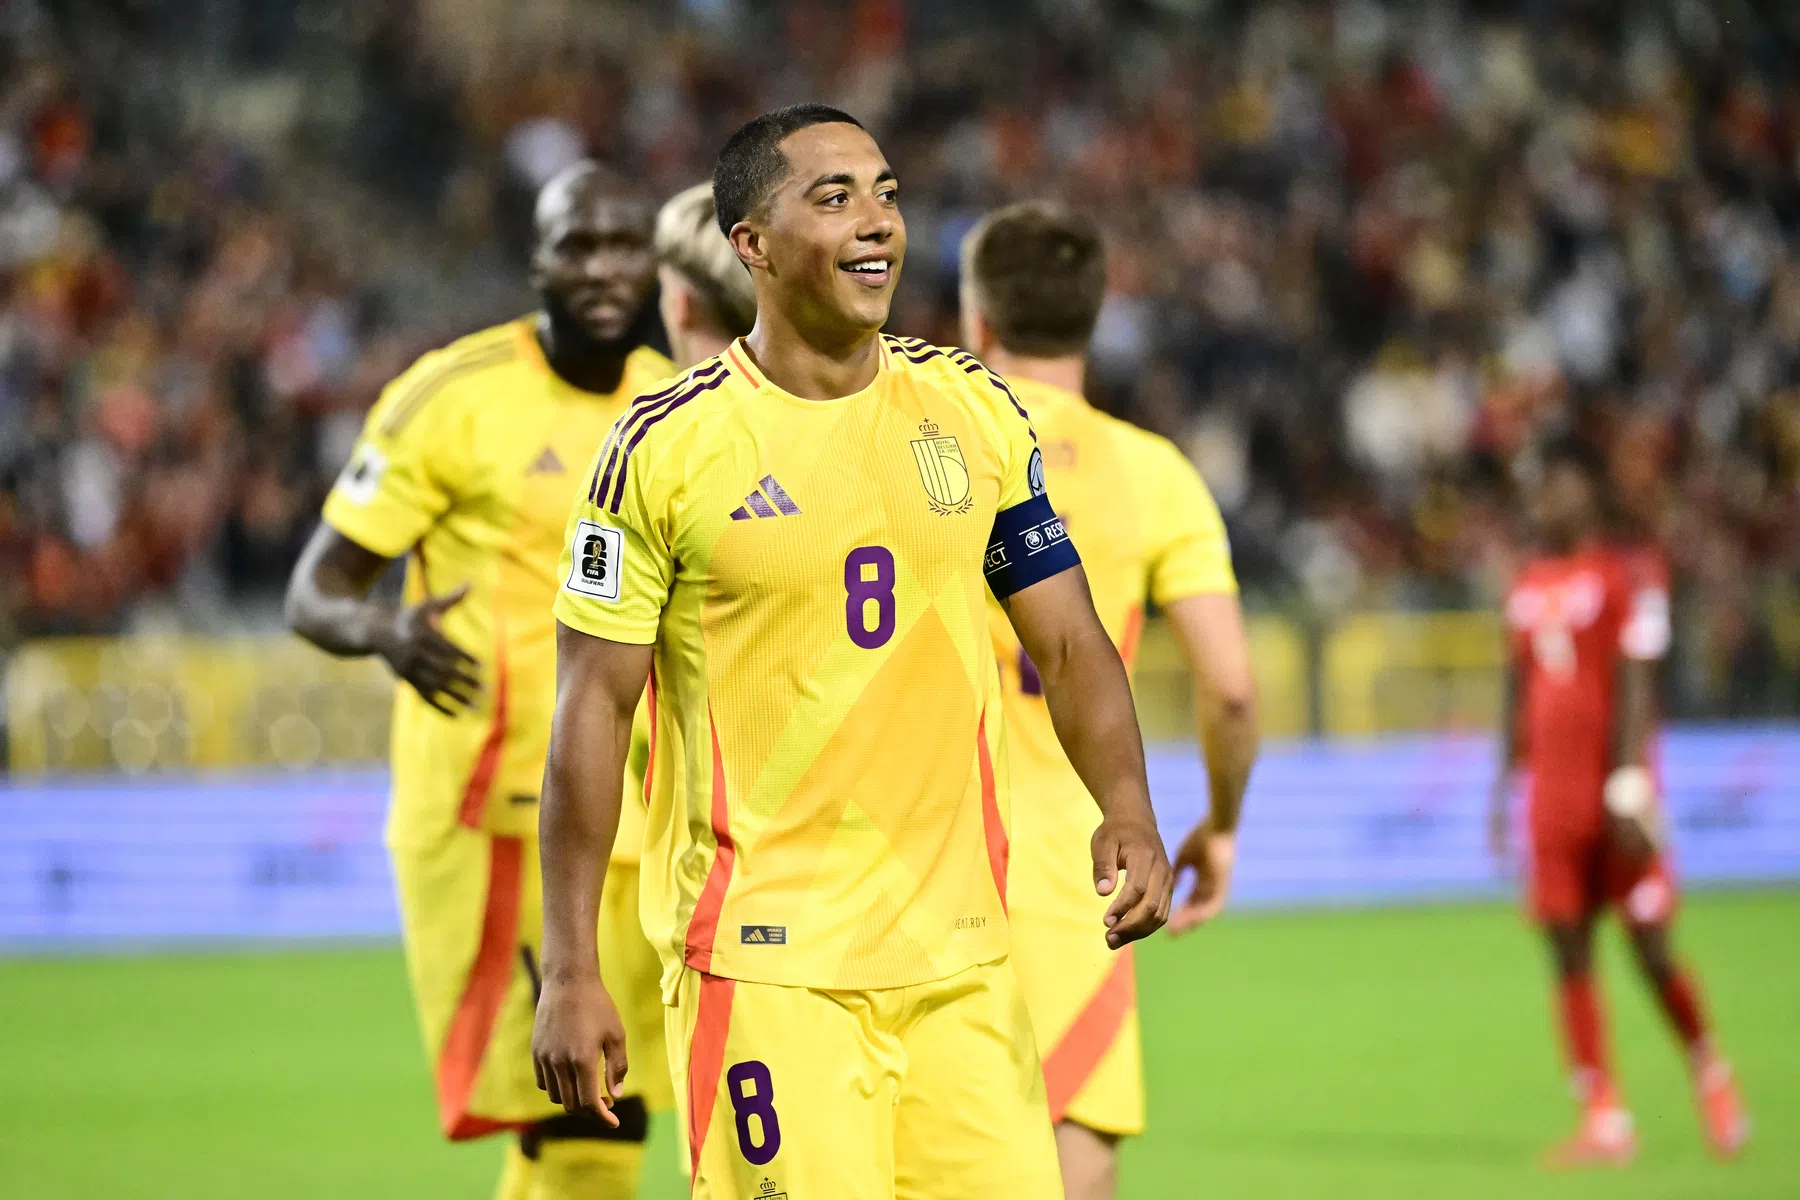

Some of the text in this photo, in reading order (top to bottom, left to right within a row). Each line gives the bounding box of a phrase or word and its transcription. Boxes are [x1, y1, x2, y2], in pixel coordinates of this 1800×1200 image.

[581, 578, 604, 587] QUALIFIERS
[586, 568, 599, 577] FIFA
[844, 545, 896, 649] 8
[727, 1060, 781, 1165] 8
